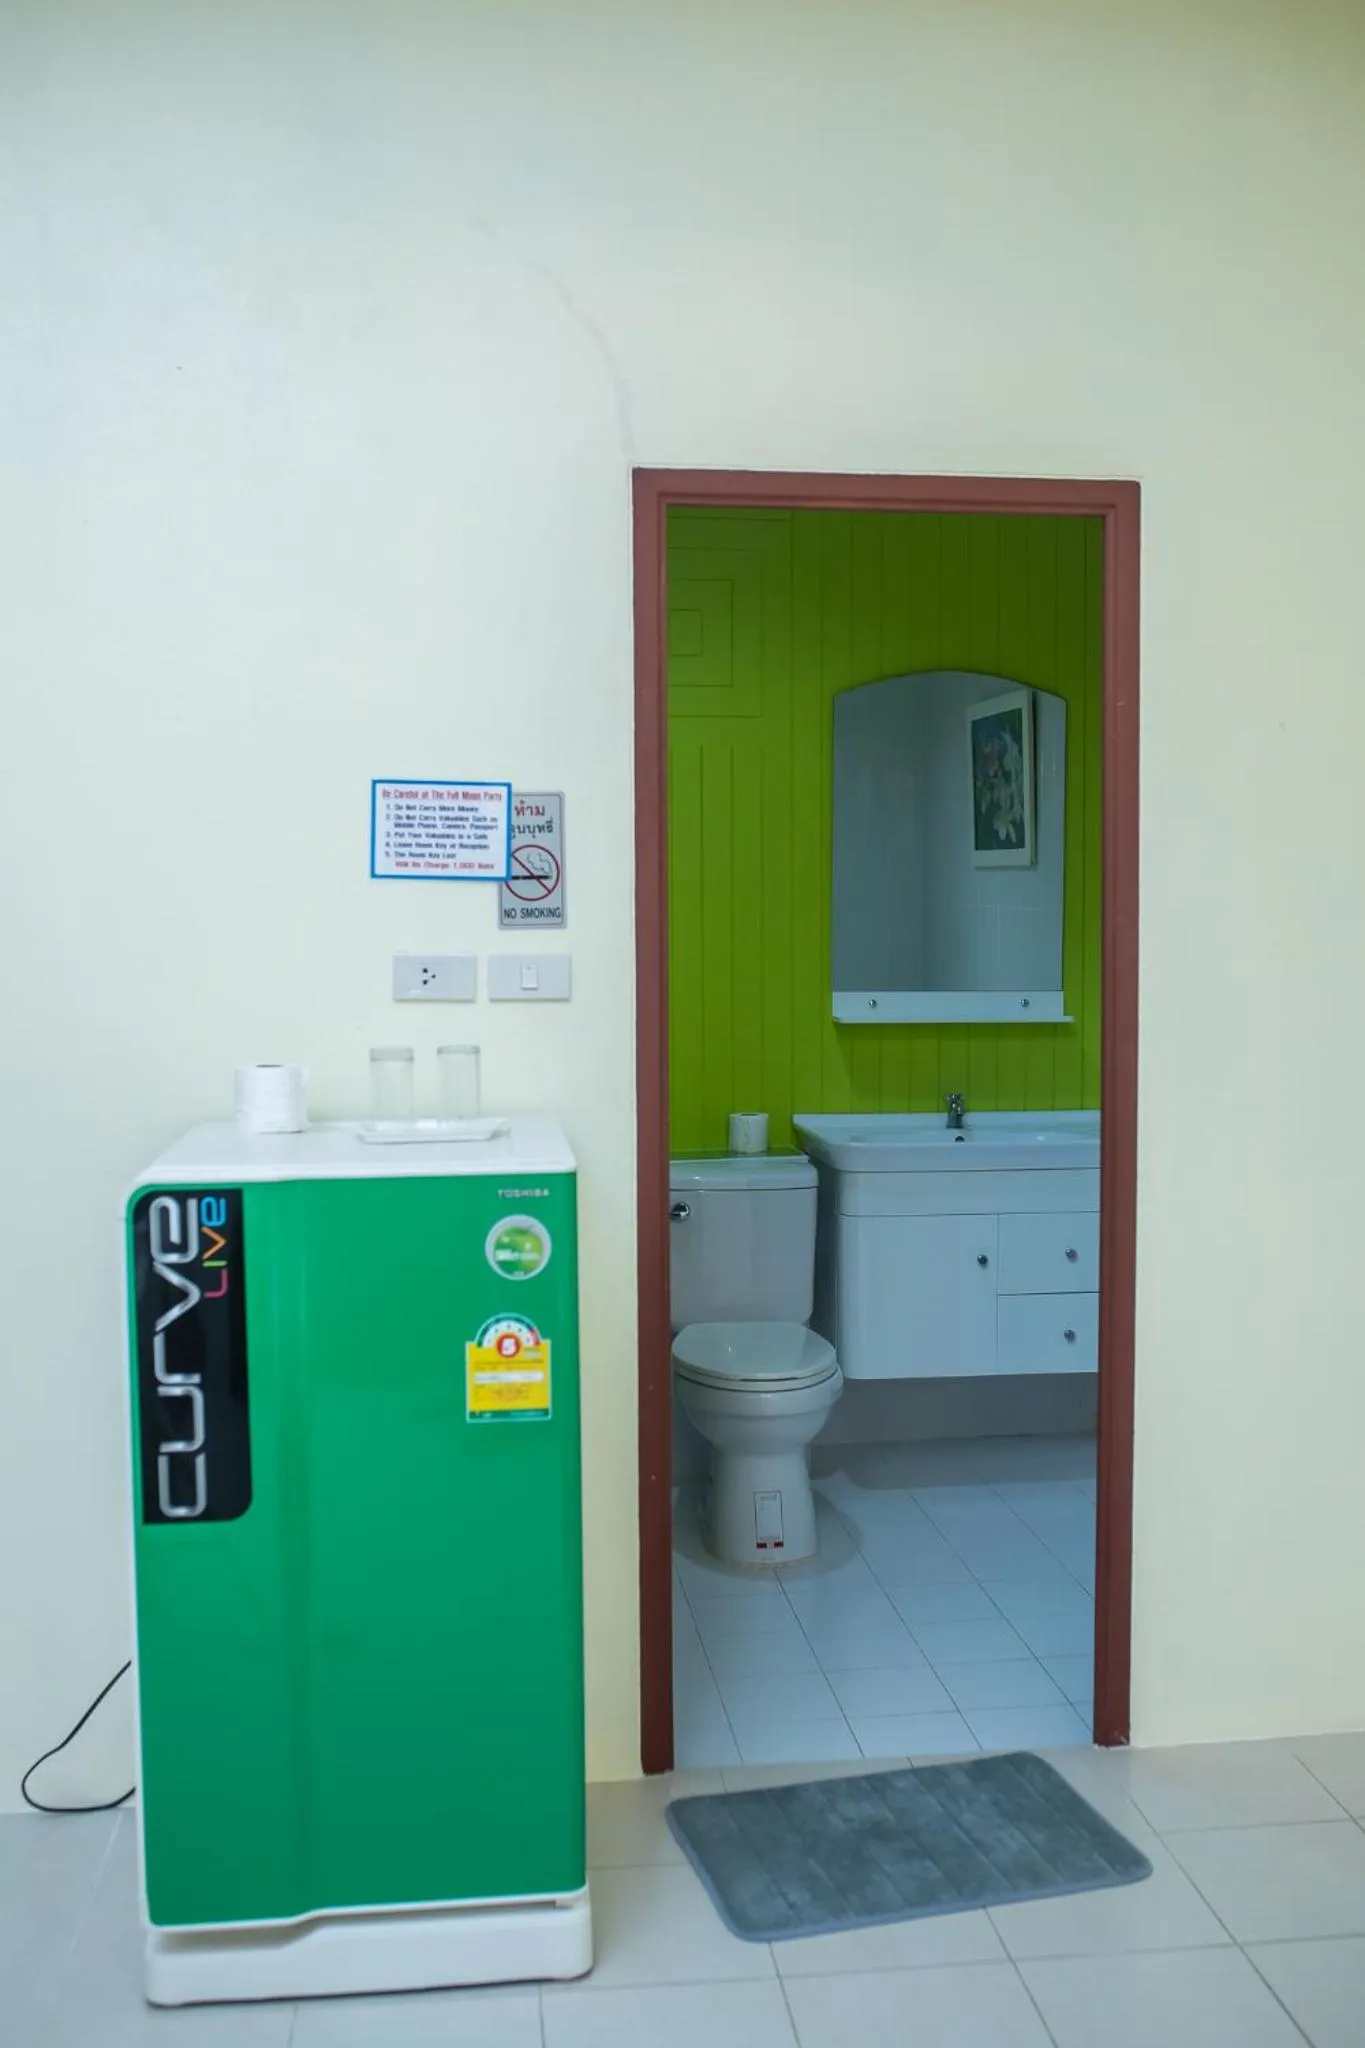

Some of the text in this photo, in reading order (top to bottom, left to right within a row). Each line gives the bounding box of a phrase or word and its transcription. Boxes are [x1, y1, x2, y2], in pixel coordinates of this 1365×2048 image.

[432, 790, 444, 799] The
[447, 790, 459, 800] Full
[514, 799, 545, 816] ห้าม
[503, 906, 561, 919] NO SMOKING
[497, 1188, 549, 1198] TOSHIBA
